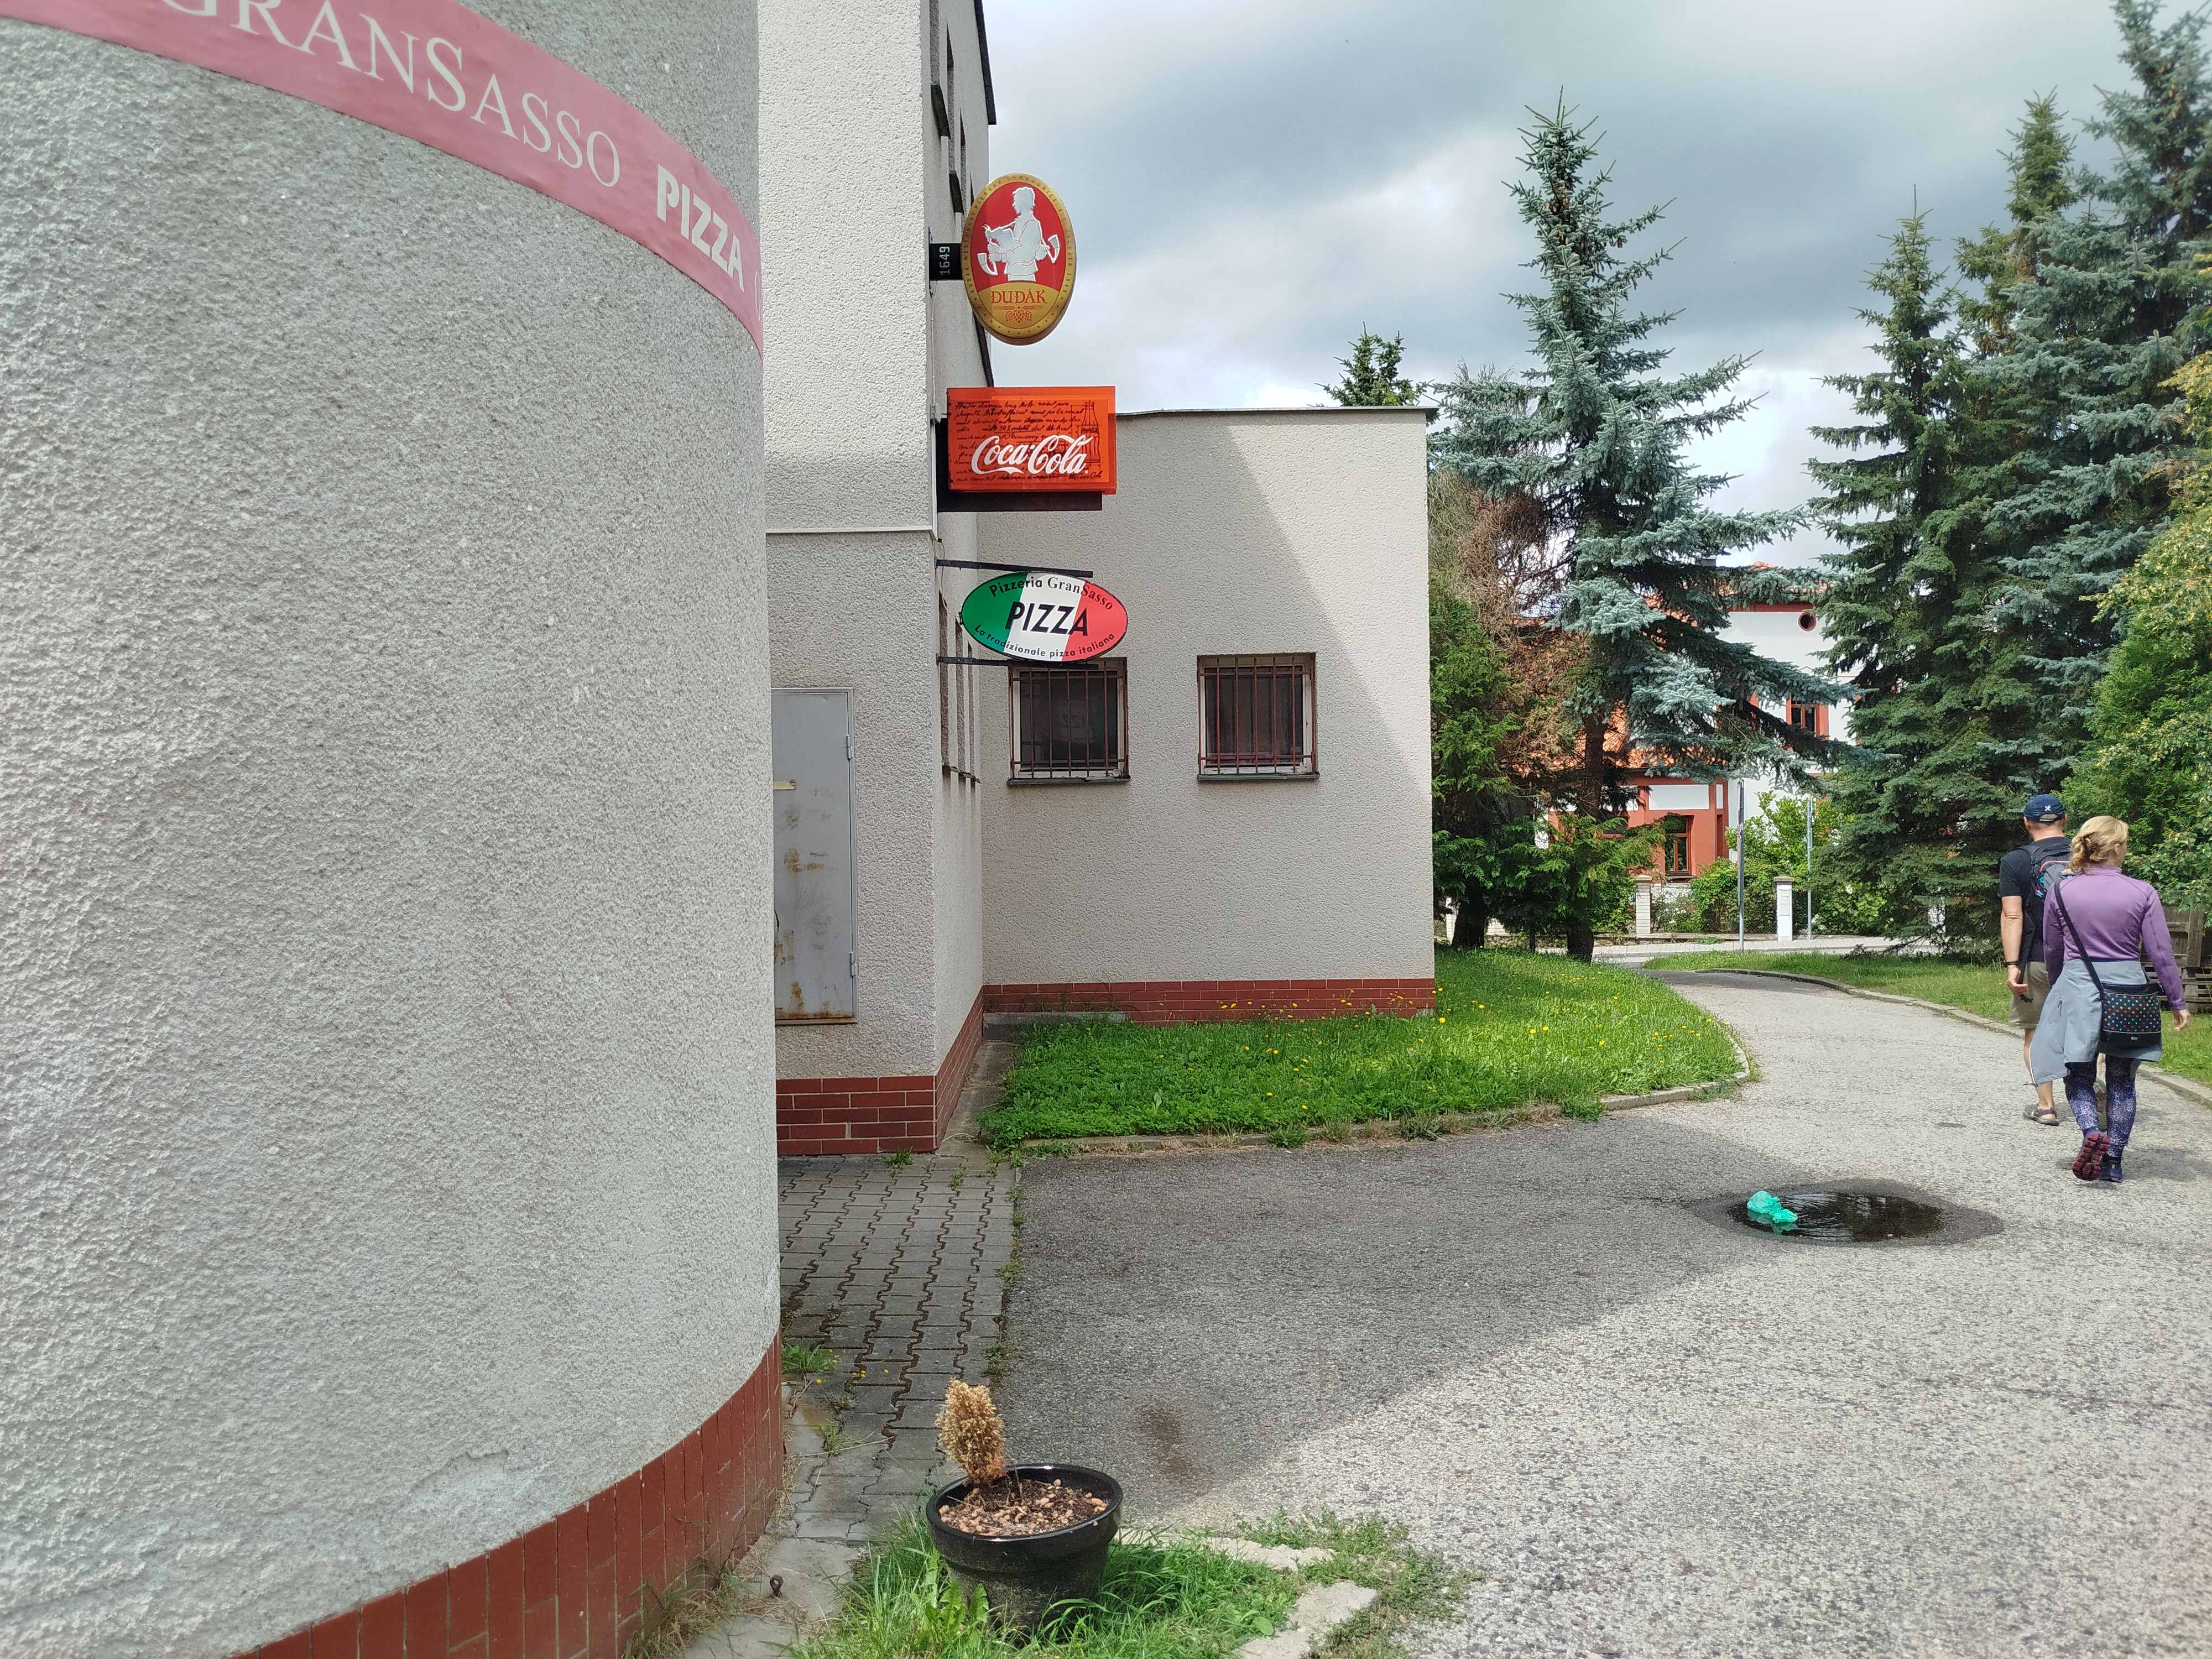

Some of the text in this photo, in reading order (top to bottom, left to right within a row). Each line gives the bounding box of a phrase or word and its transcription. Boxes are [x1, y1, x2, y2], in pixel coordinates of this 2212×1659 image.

[163, 0, 744, 293] RANSASSO PIZZA
[974, 180, 1003, 209] PIVOVAR
[939, 246, 950, 276] 1649
[990, 288, 1047, 304] DUDÁK
[971, 435, 1093, 475] Coca-Cola
[989, 576, 1113, 610] Pizzeria GranSasso
[1005, 601, 1088, 637] PIZZA
[974, 624, 1115, 659] La tradizionale pizza italiana
